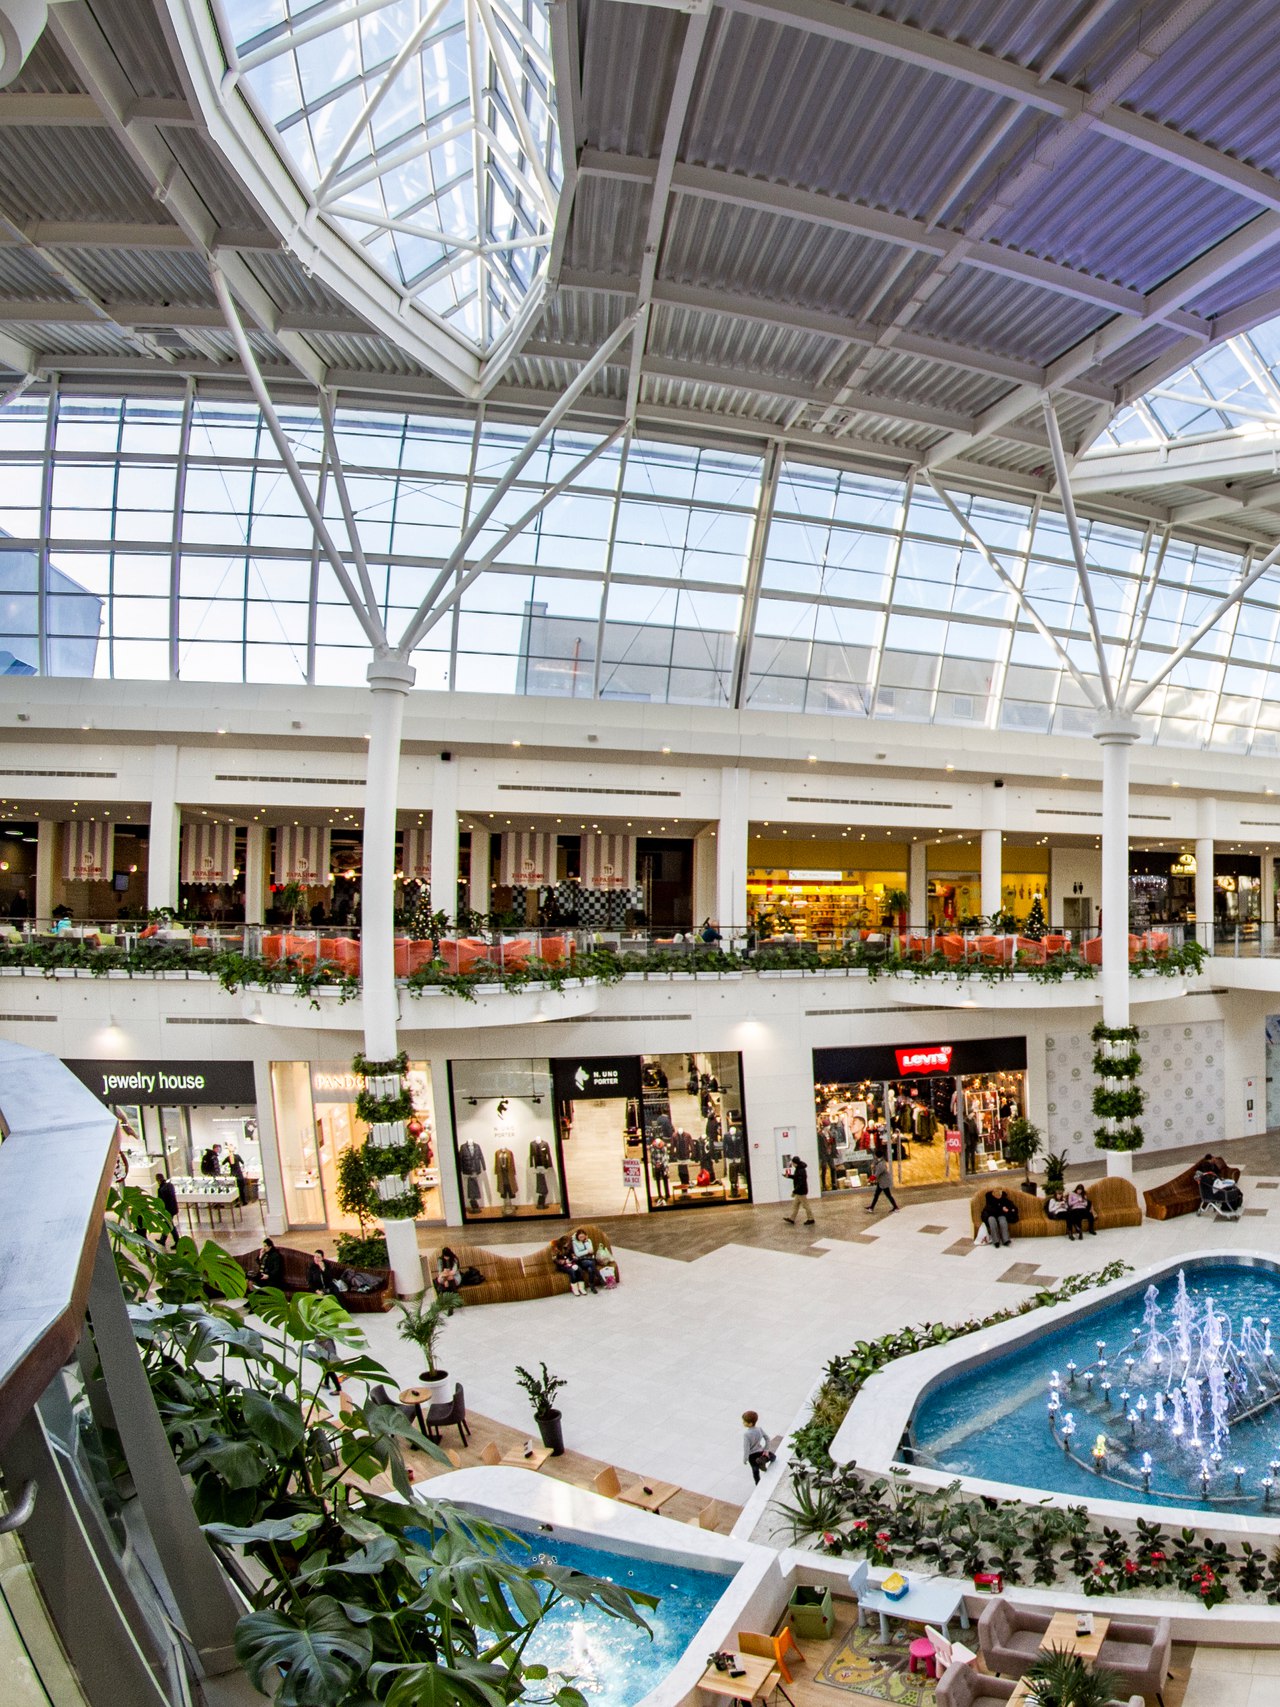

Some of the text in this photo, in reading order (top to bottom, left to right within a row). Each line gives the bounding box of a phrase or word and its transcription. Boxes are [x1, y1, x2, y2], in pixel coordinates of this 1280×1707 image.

[602, 1070, 618, 1078] UNO
[102, 1072, 205, 1095] jewelry house
